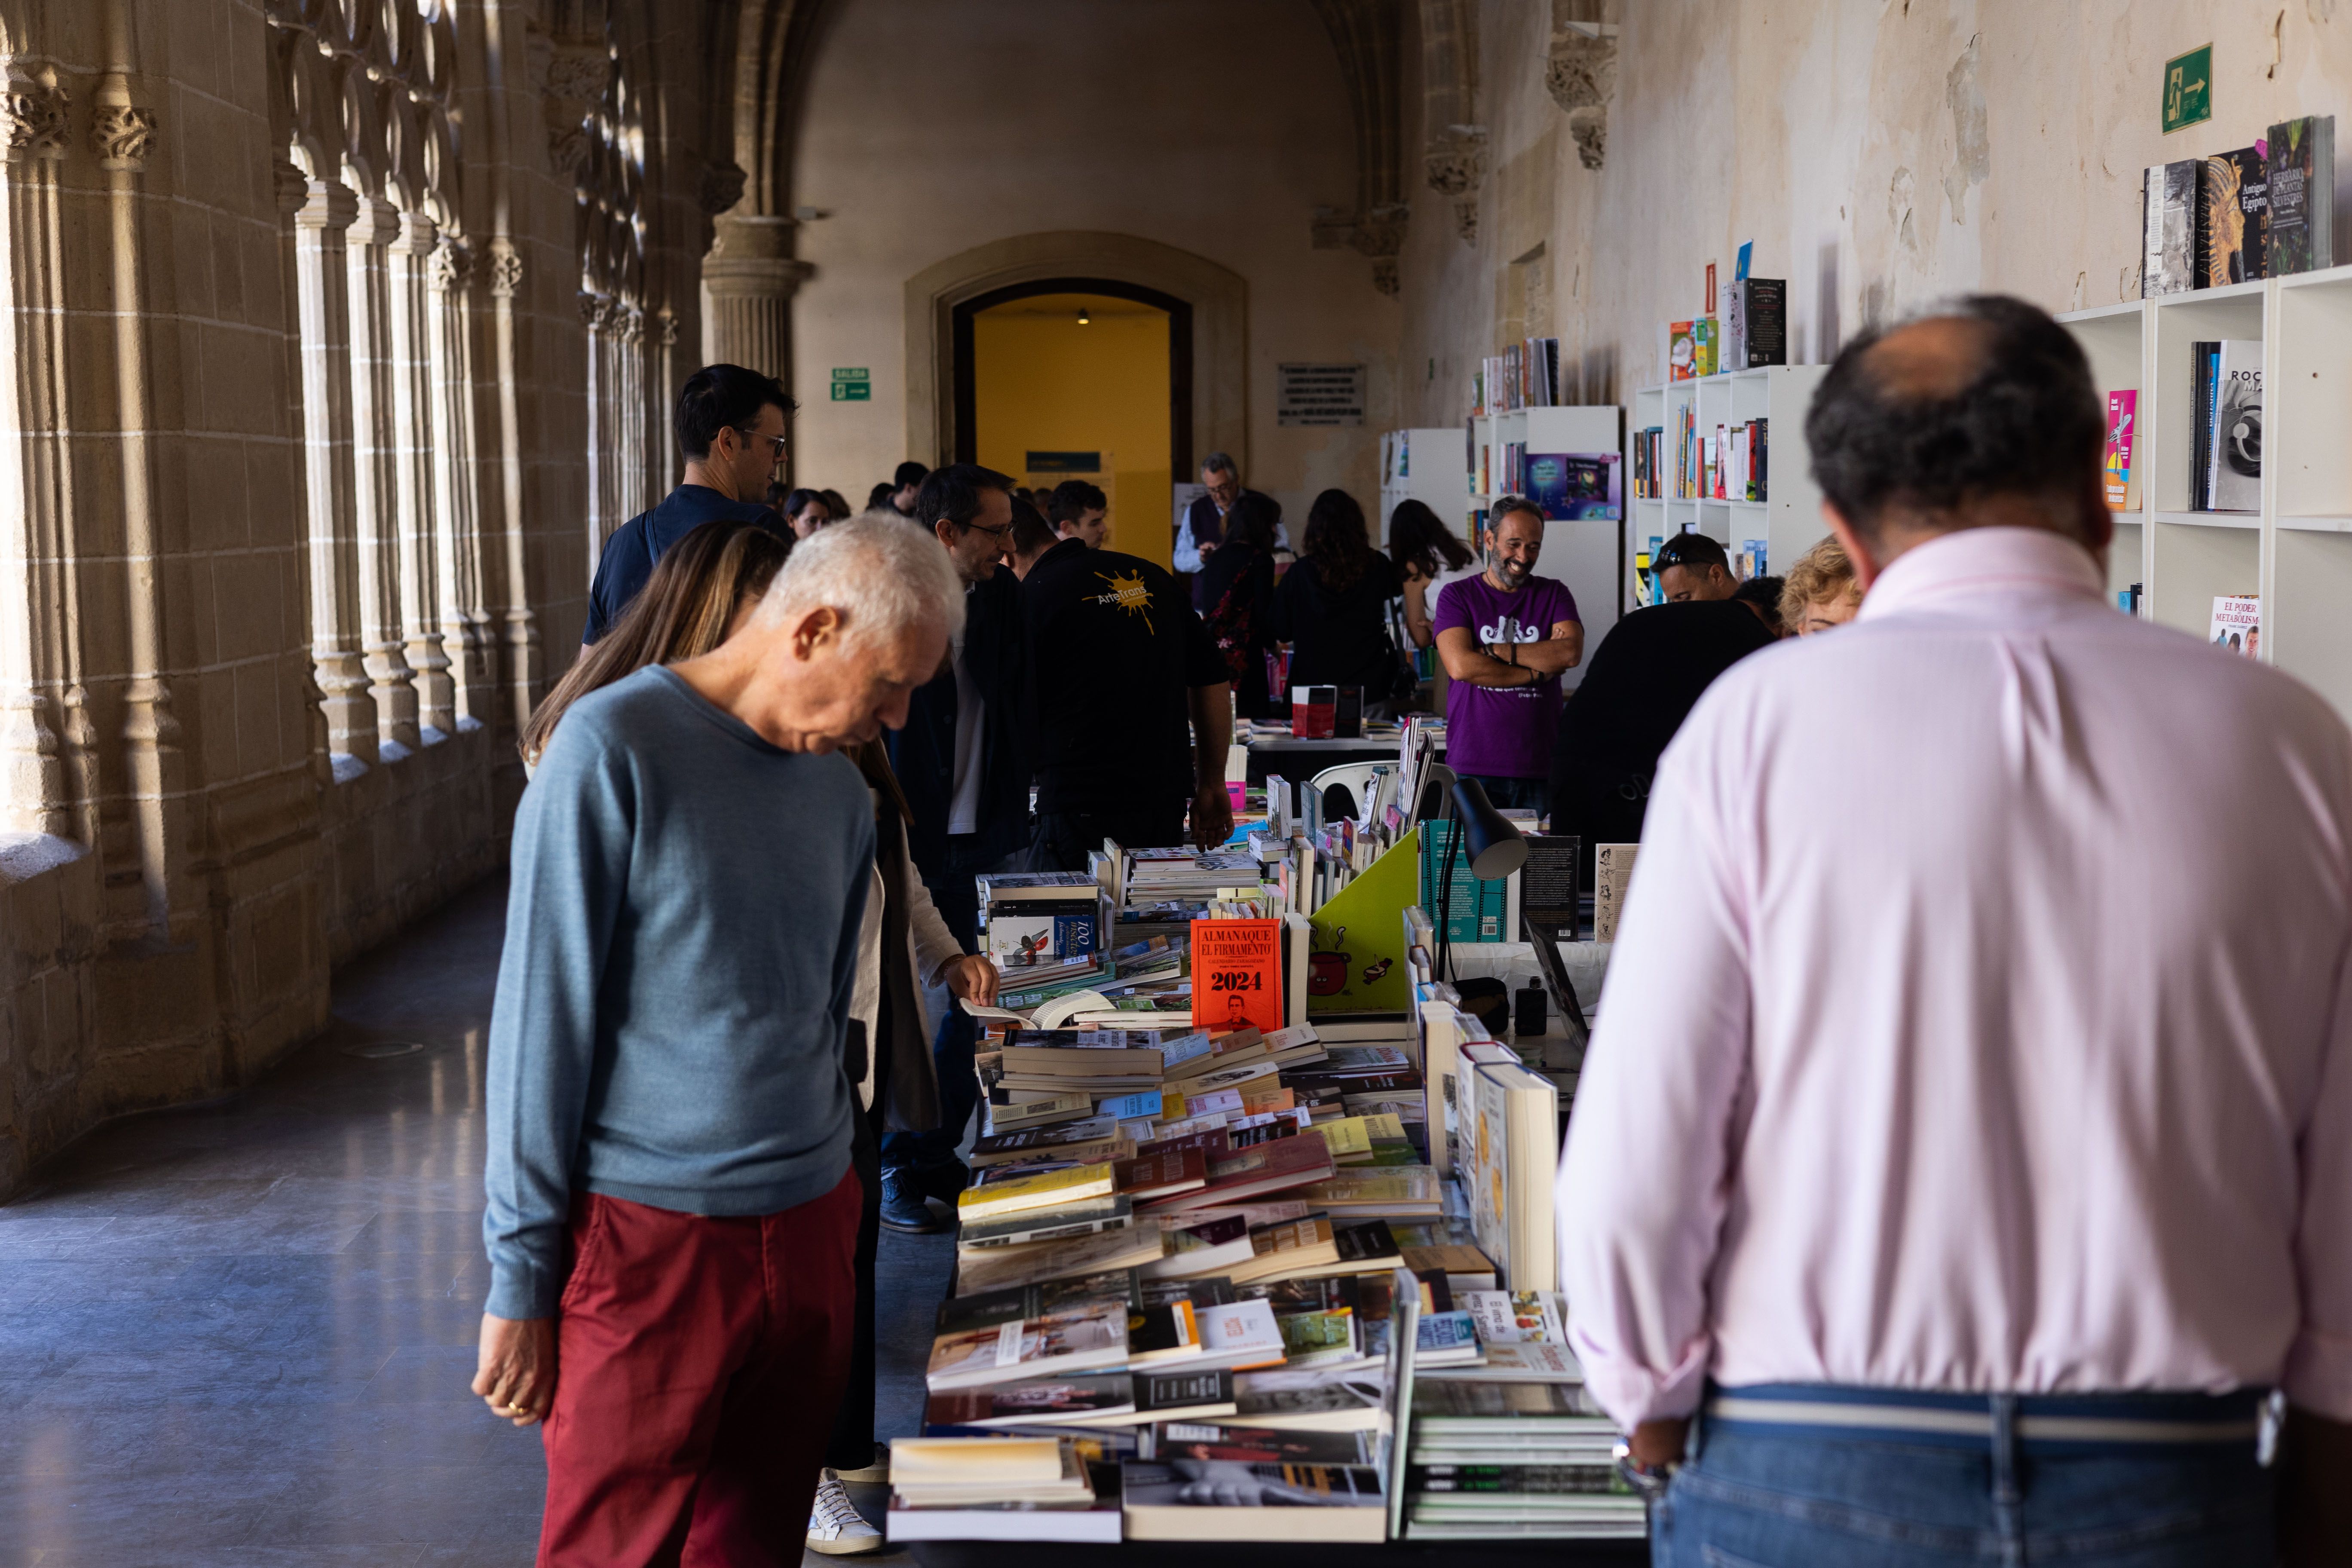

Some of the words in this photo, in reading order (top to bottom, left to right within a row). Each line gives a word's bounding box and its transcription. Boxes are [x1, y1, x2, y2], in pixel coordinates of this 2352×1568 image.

[2242, 183, 2267, 196] Antiguo
[2242, 196, 2267, 212] Egipto
[835, 369, 866, 379] SALIDA
[1098, 586, 1147, 605] ArteTrans
[2225, 602, 2233, 611] EL
[2235, 603, 2257, 613] PODER
[2215, 613, 2259, 625] METABOLISM
[1070, 922, 1080, 957] insectos
[1202, 930, 1271, 943] ALMANAQUE
[1202, 944, 1212, 955] EL
[1214, 943, 1271, 955] FIRMAMENTO
[1211, 971, 1262, 991] 2024
